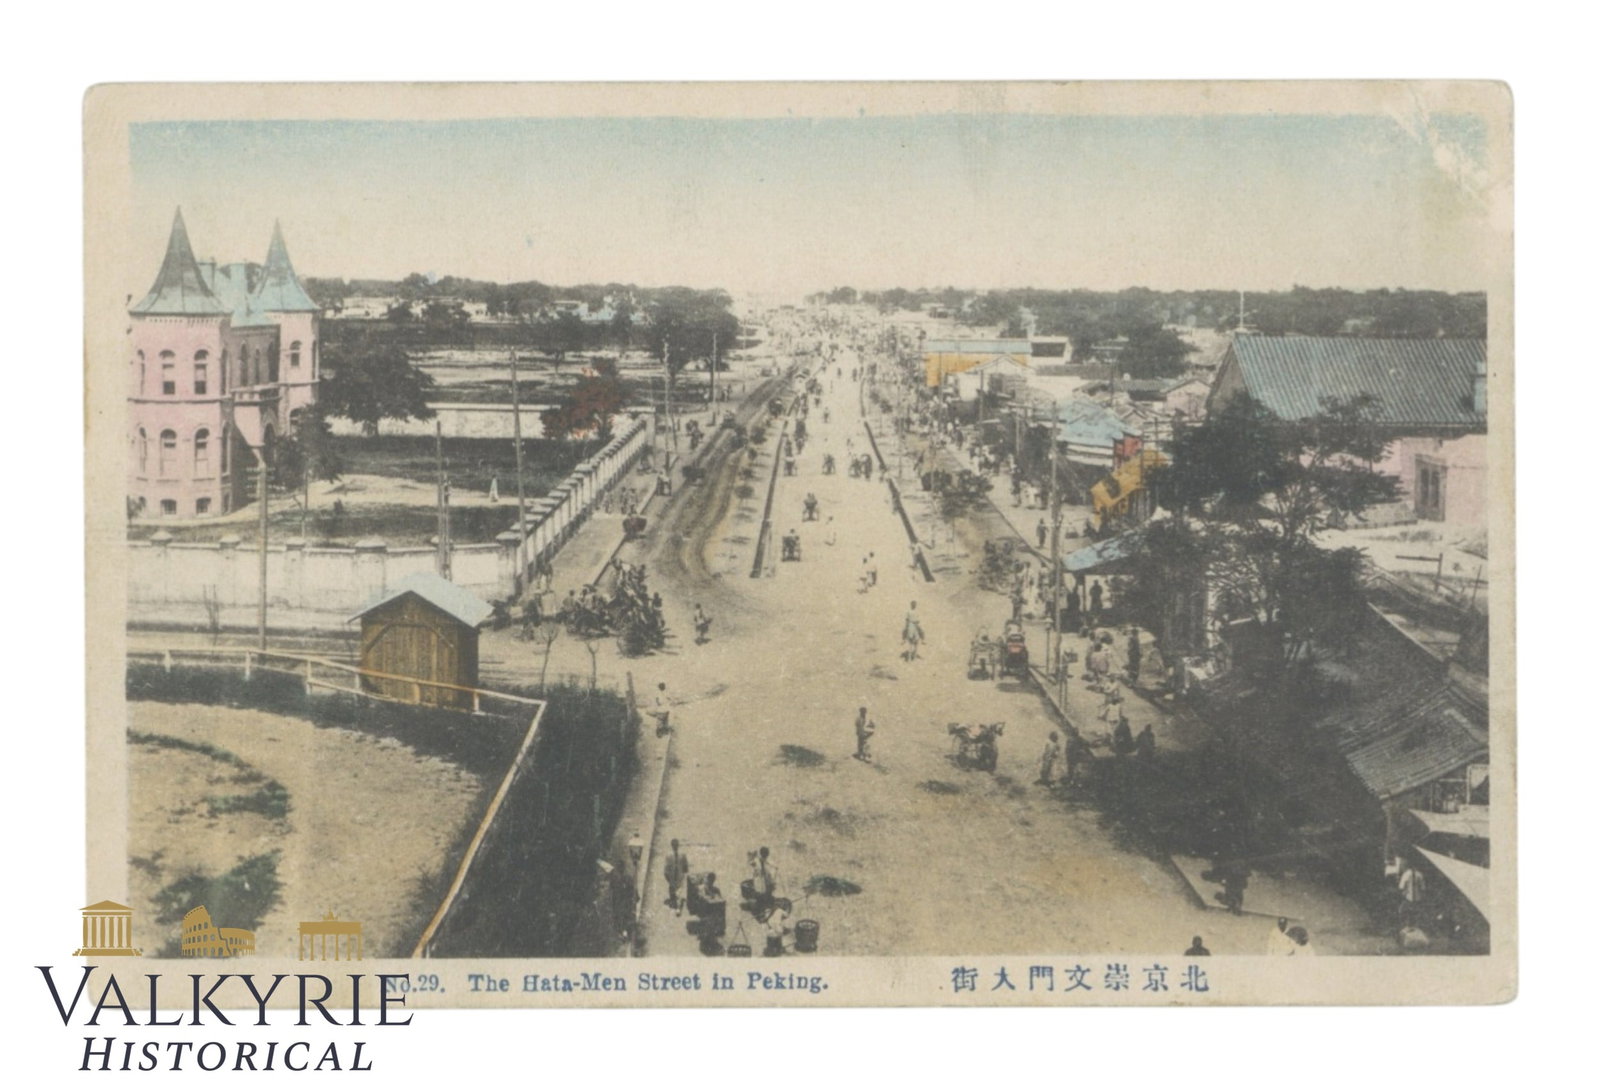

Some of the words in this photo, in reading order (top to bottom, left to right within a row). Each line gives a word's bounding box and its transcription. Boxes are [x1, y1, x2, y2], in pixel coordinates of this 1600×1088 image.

[467, 973, 510, 993] The
[522, 972, 627, 993] Hata-Men
[638, 972, 702, 992] Street
[712, 972, 735, 992] in
[747, 971, 829, 995] Peking.
